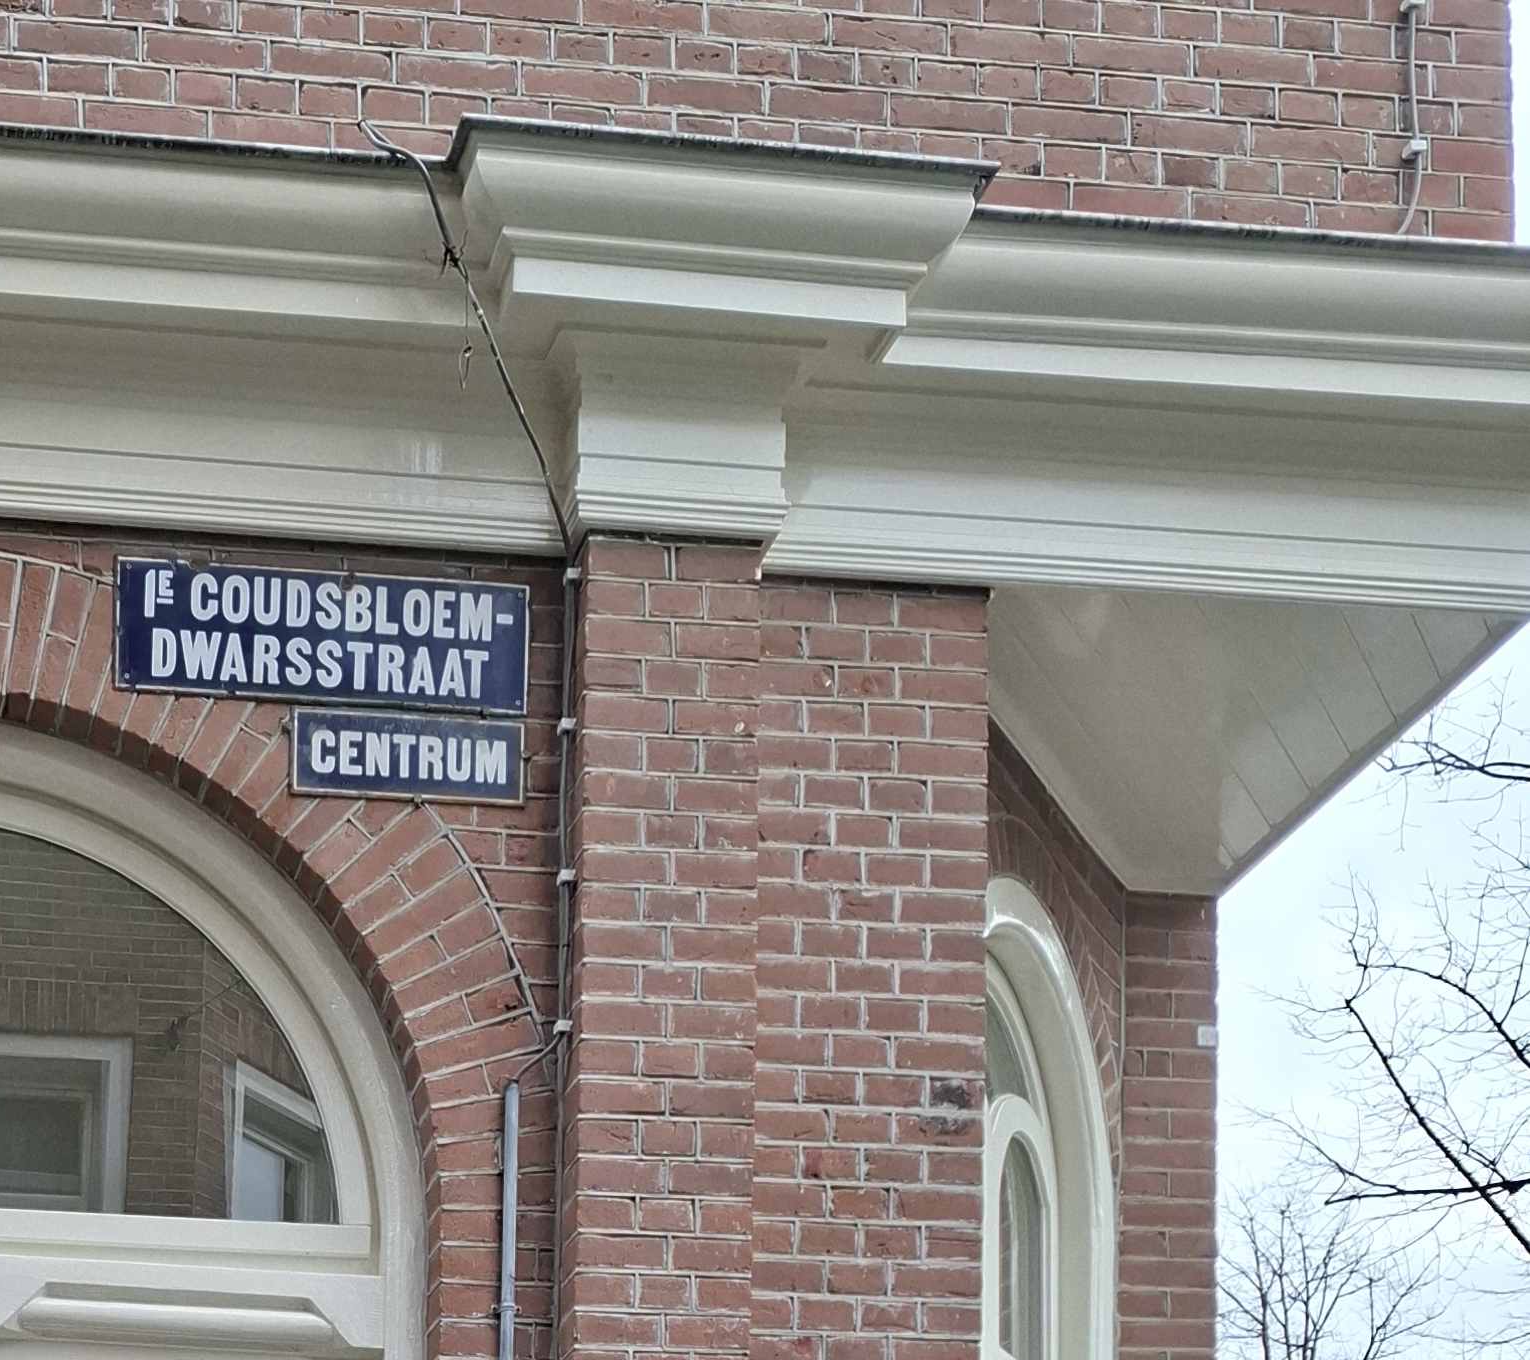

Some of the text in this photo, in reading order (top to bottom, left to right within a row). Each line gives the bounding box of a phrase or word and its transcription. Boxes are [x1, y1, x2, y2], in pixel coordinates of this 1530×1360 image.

[189, 572, 514, 642] GOUDSBLOEM-
[151, 627, 490, 699] DWARSSTRAAT
[310, 728, 508, 785] CENTRUM
